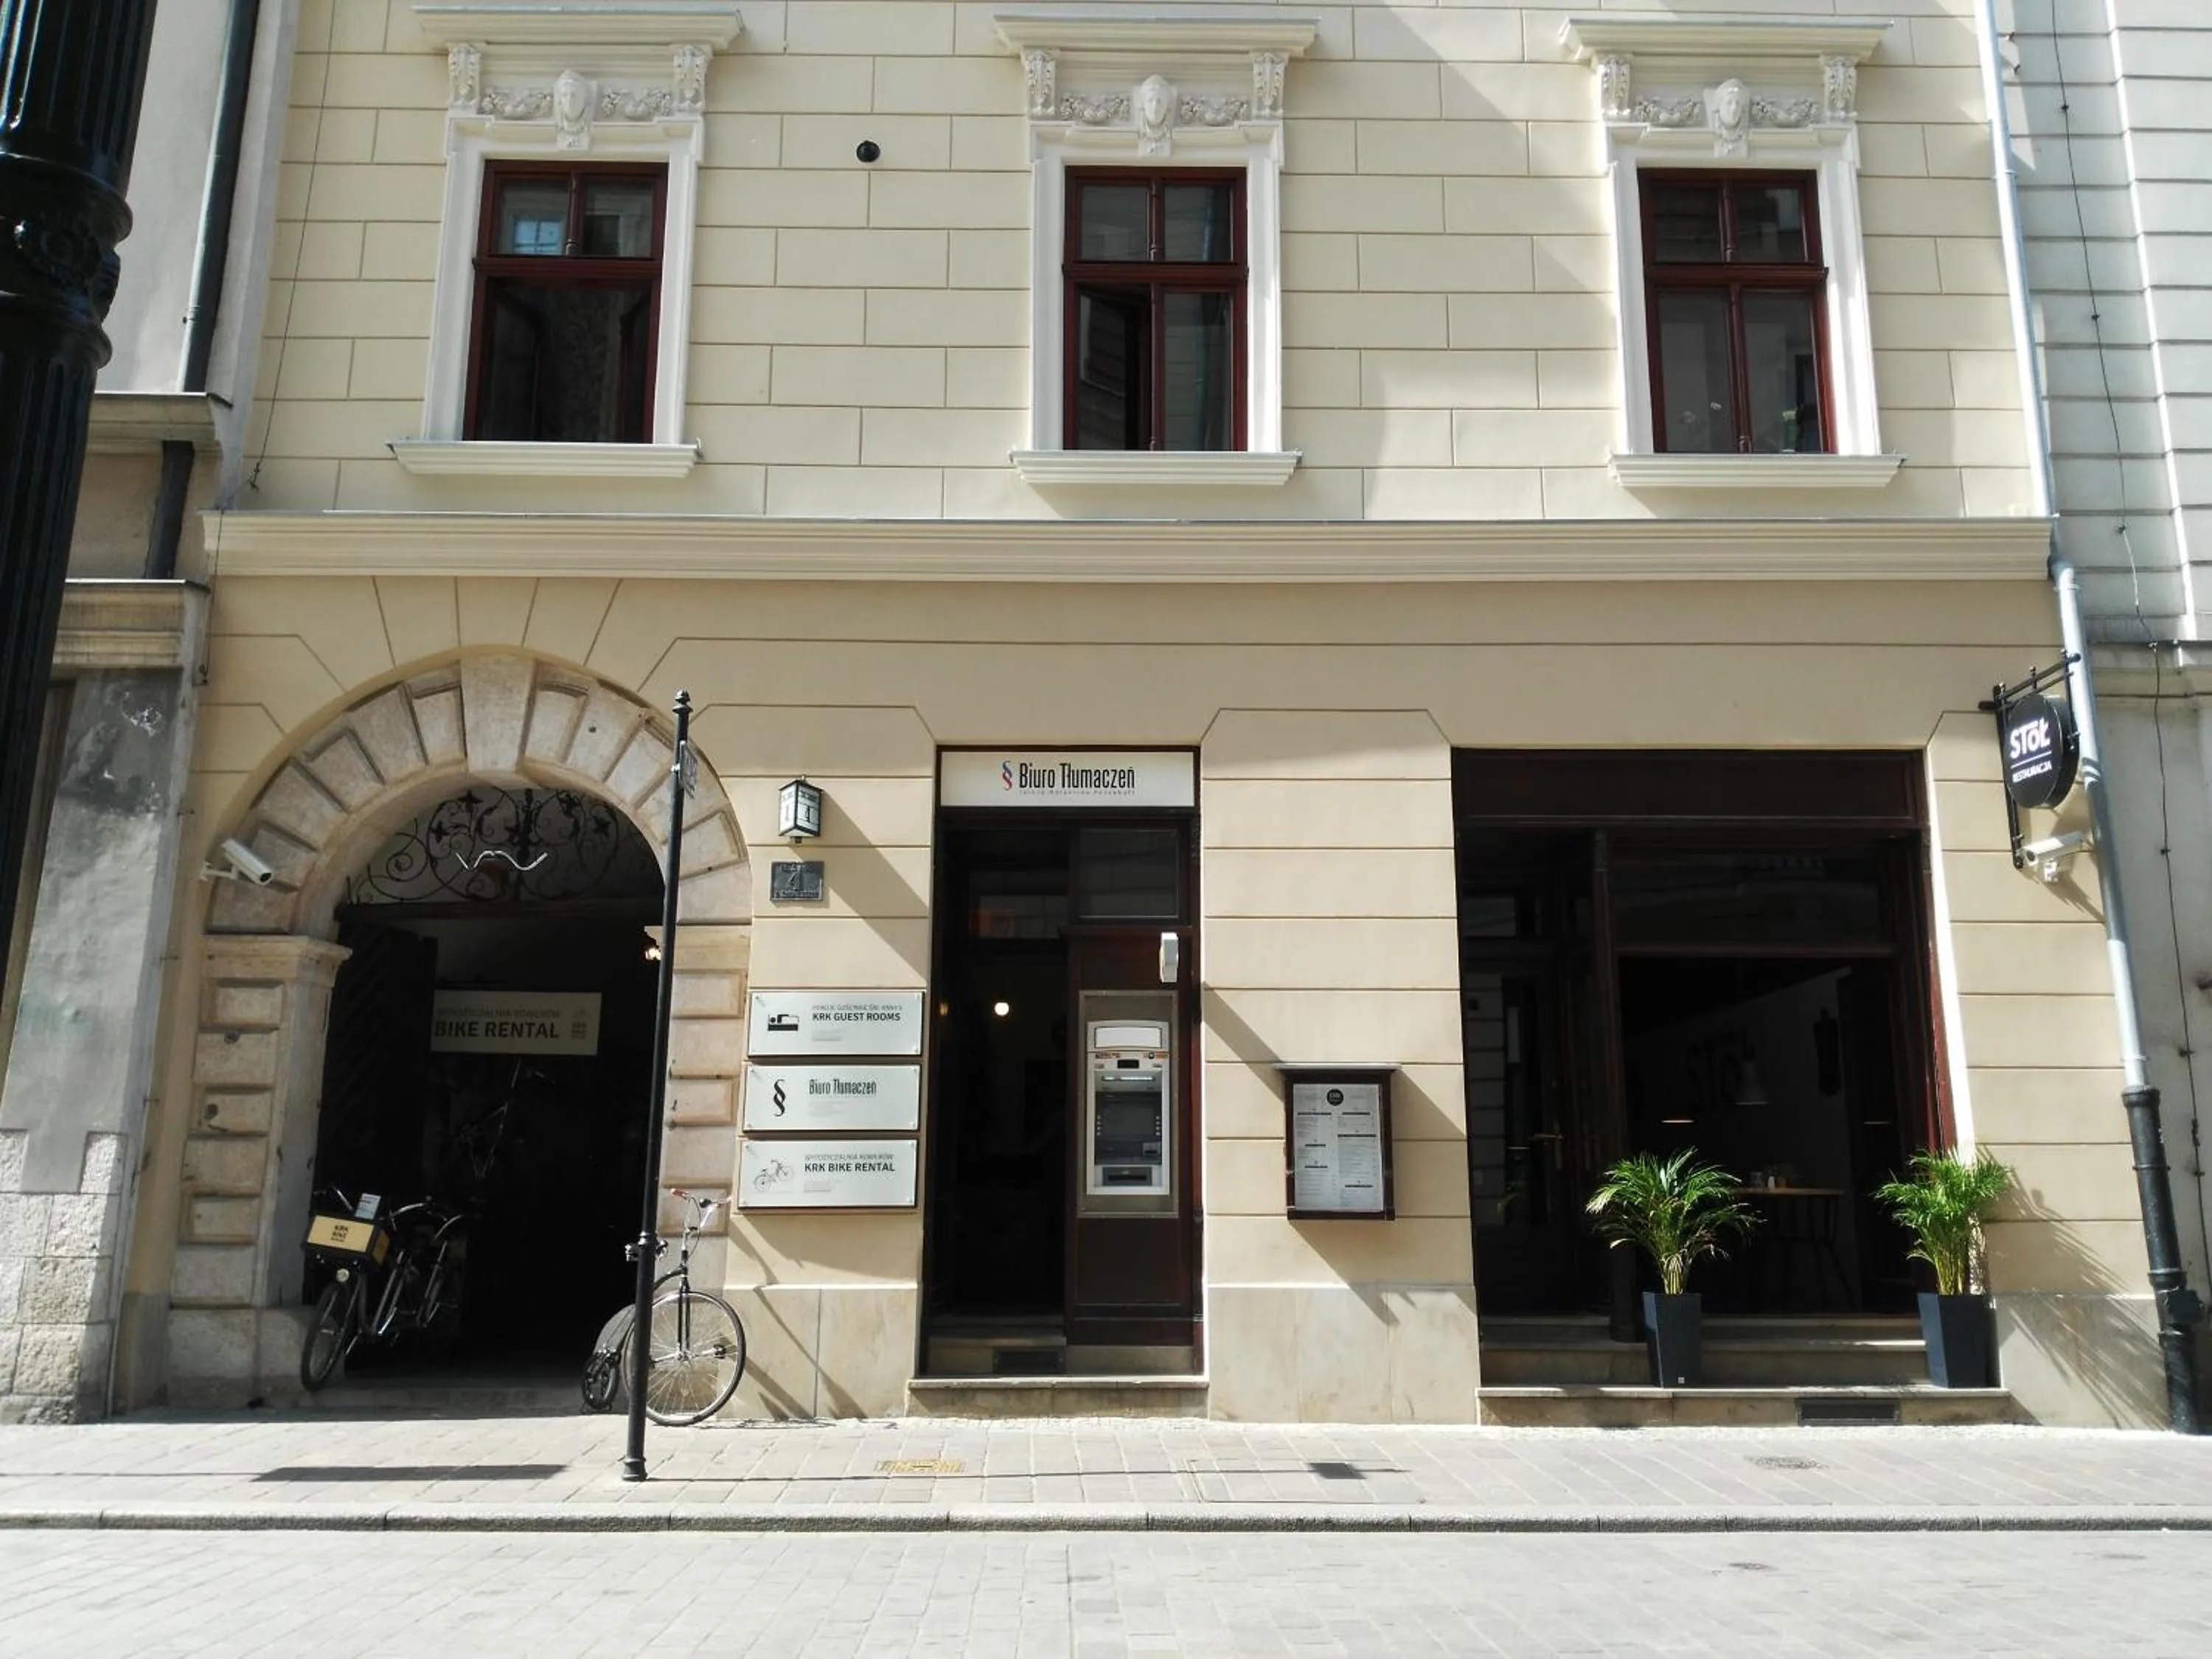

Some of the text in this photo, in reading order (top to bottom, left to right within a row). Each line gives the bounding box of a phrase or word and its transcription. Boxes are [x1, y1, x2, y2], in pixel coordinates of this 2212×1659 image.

[1019, 762, 1055, 788] Biuro
[1059, 762, 1135, 788] Tłumaczeń
[813, 1012, 901, 1021] KRK GUEST ROOMS
[434, 1020, 480, 1038] BIKE
[484, 1020, 560, 1039] RENTAL
[809, 1079, 831, 1095] Biuro
[804, 1162, 895, 1172] KRK BIKE RENTAL
